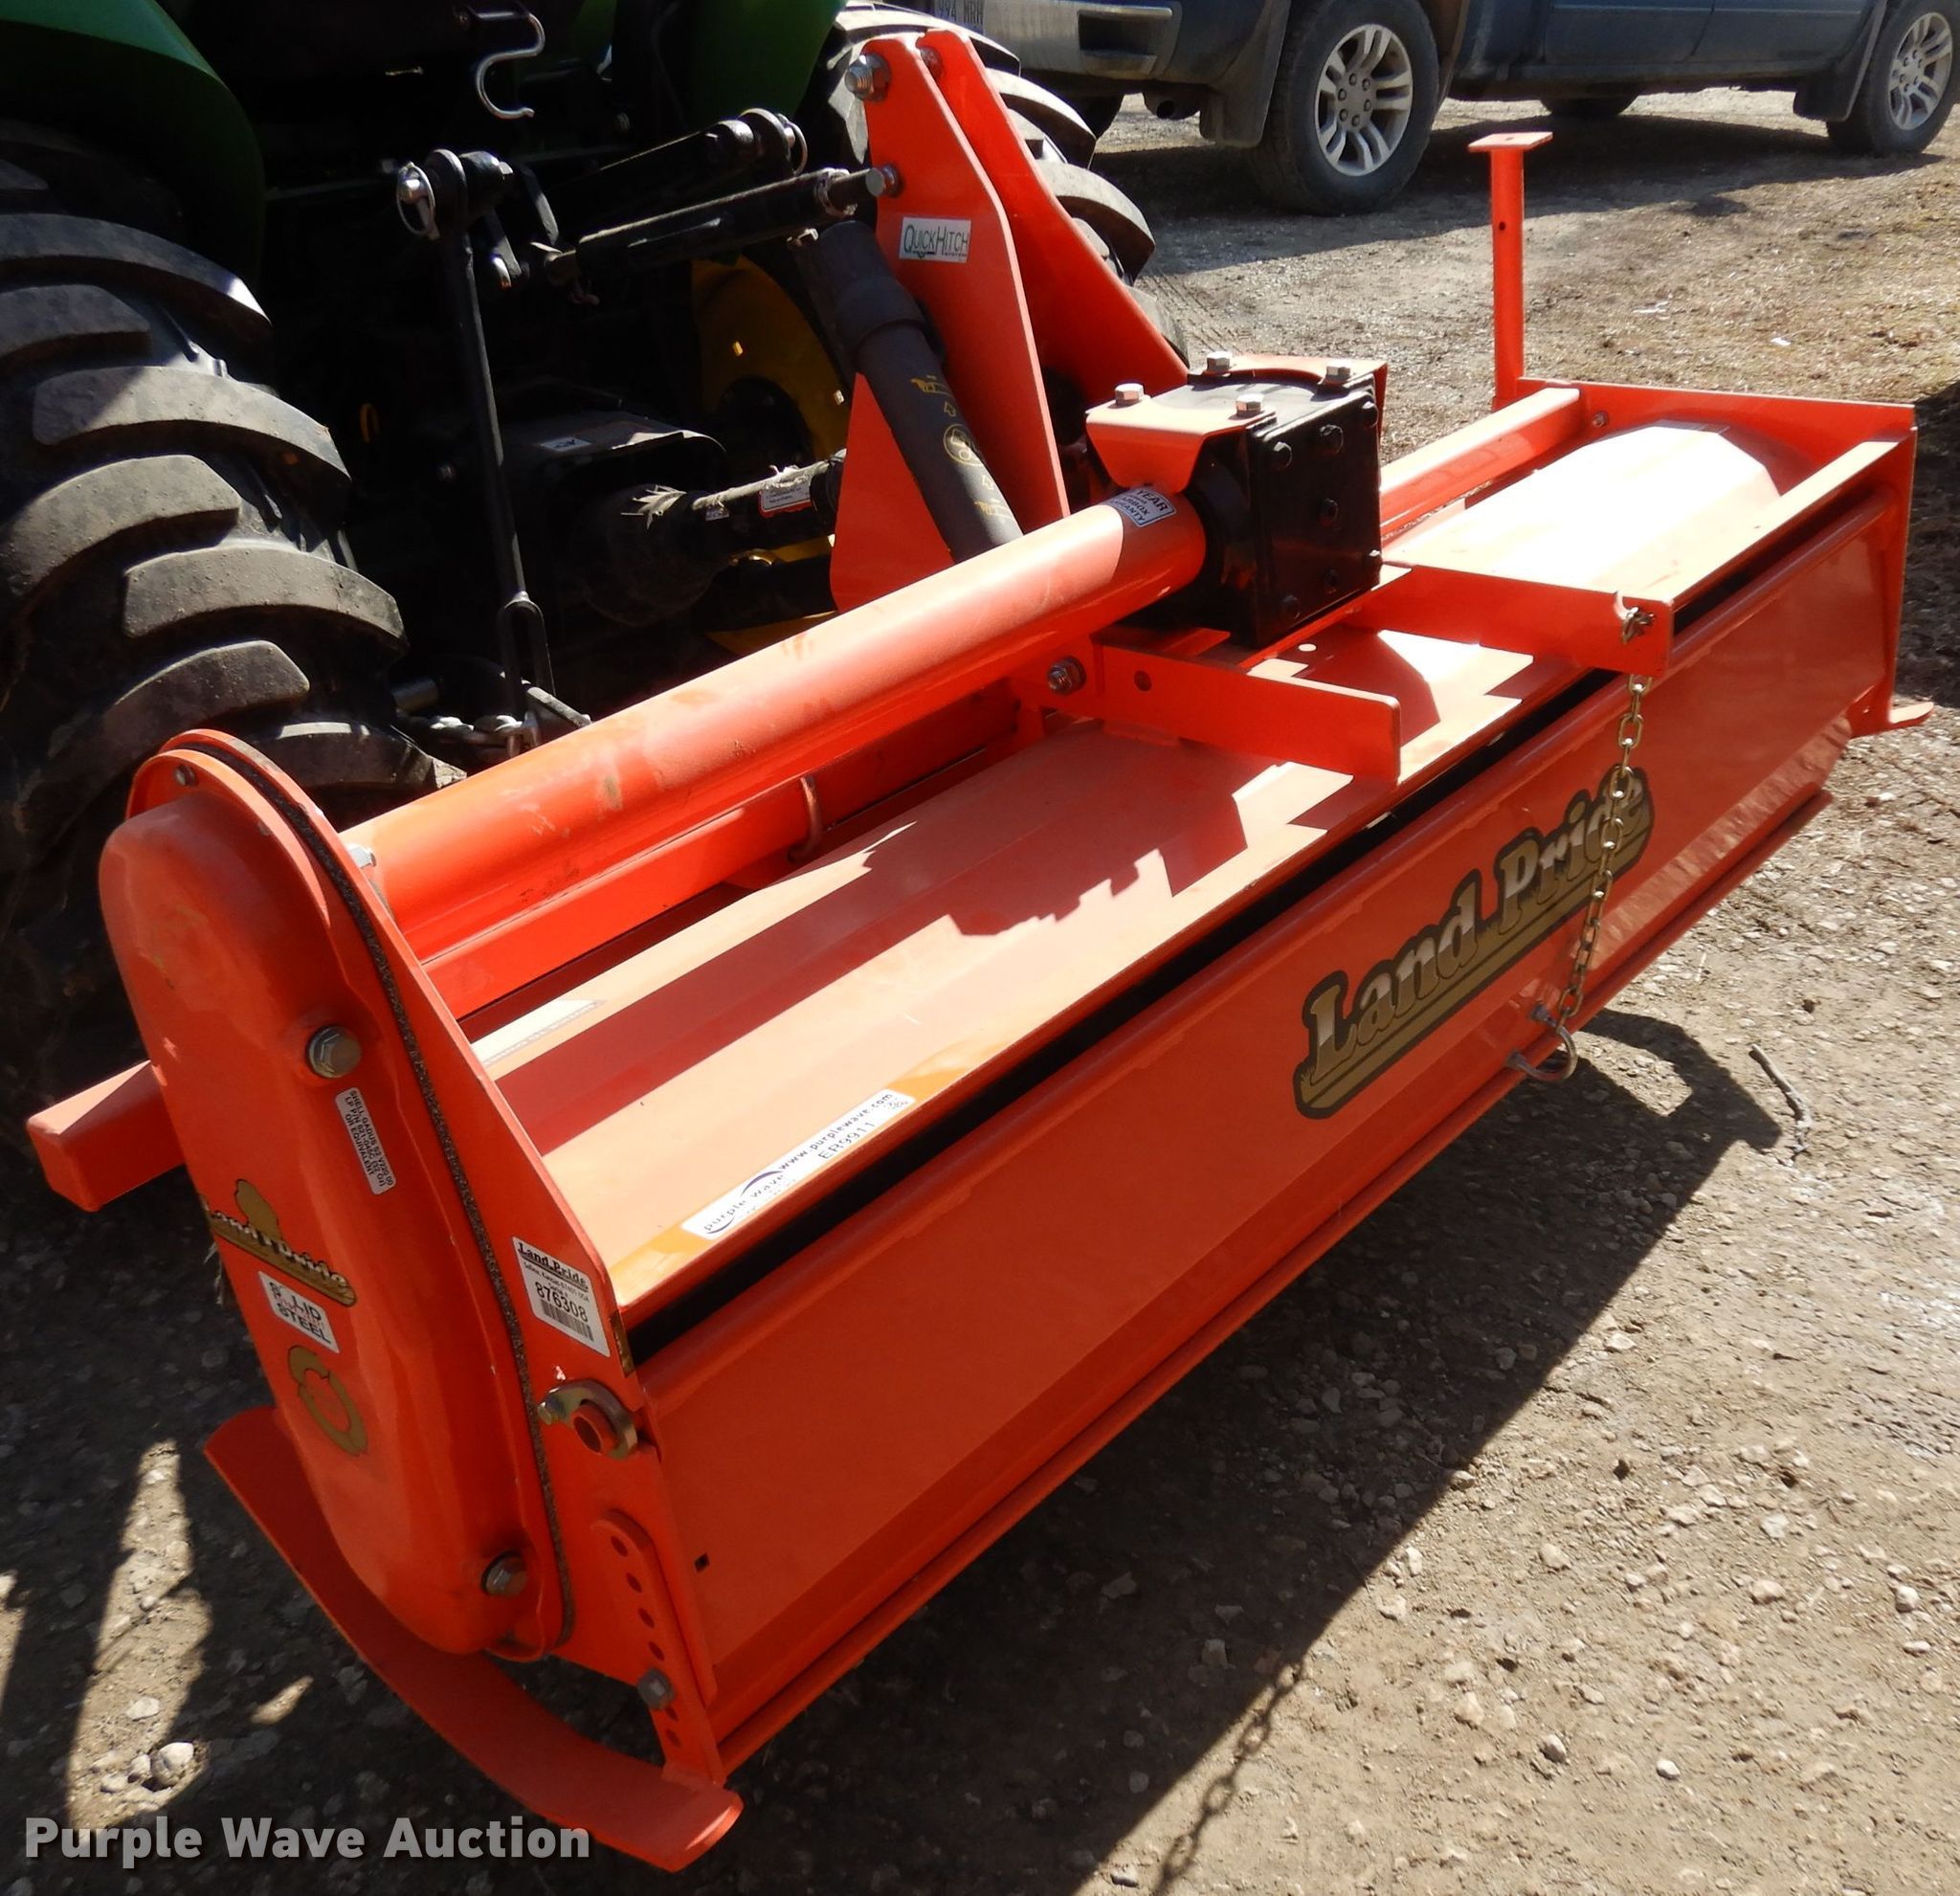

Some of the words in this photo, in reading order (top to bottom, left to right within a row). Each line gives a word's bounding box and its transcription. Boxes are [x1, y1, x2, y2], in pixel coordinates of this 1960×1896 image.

[1309, 881, 1479, 1086] Land
[1499, 770, 1648, 936] Pride
[778, 1093, 894, 1171] www.purplewave.com
[518, 1242, 549, 1267] Land
[552, 1258, 587, 1289] Pride
[277, 1303, 331, 1344] STEEL
[535, 1282, 589, 1323] 876308
